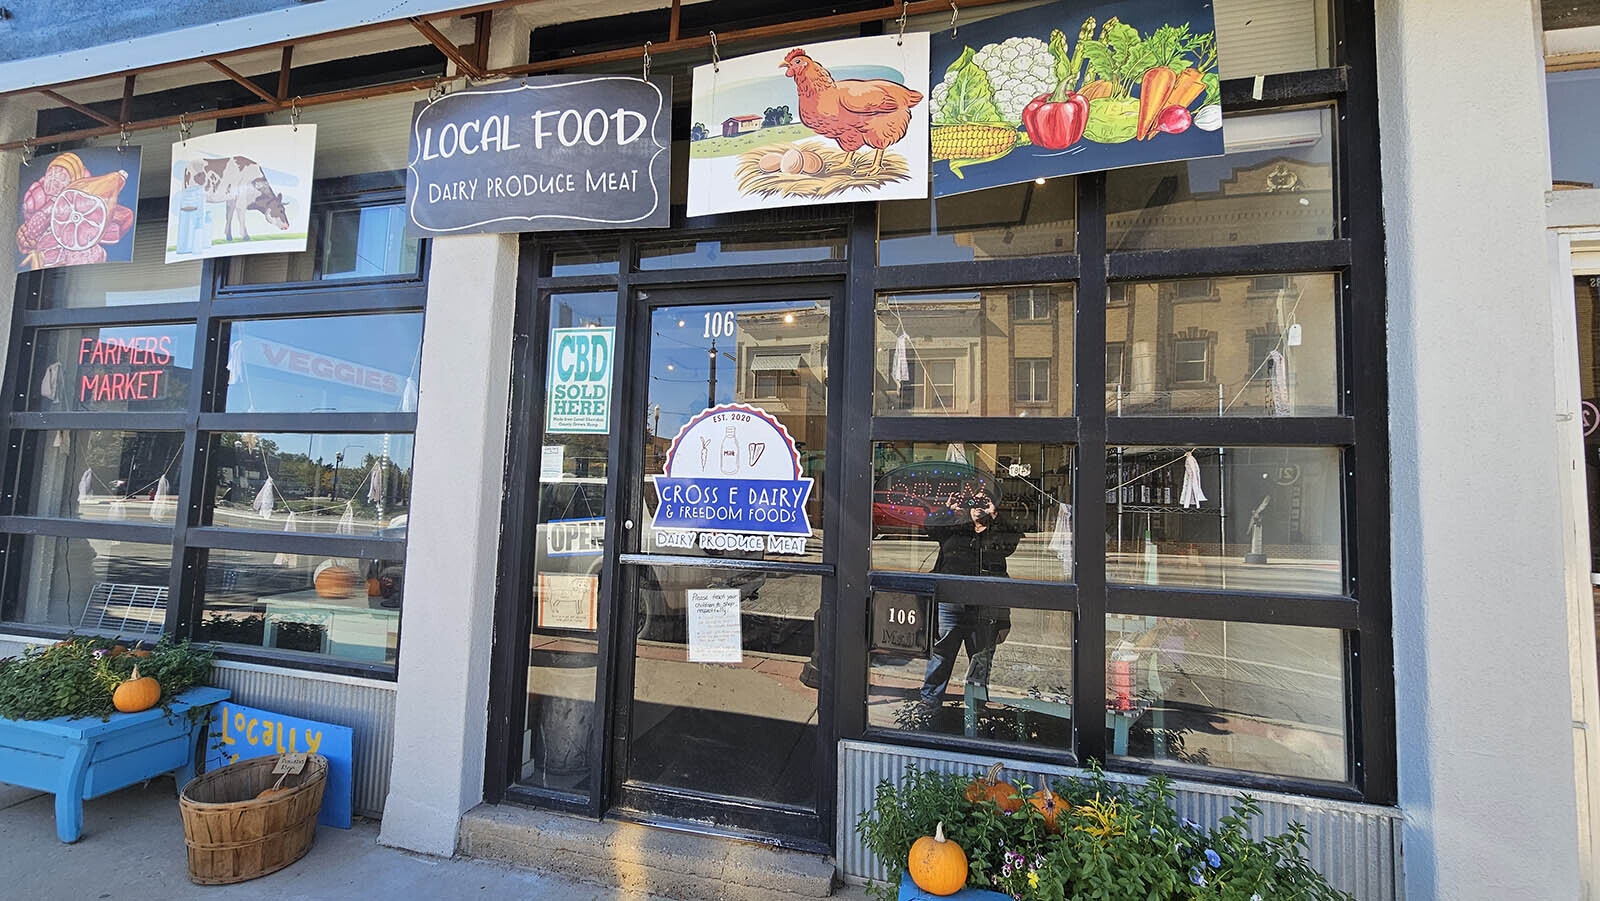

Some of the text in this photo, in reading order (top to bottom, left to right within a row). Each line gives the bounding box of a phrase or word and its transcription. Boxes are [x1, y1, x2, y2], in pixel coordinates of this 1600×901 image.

[423, 108, 647, 161] LOCAL FOOD
[429, 169, 638, 204] DAIRY PRODUCE MEAT
[704, 311, 735, 338] 106
[79, 336, 172, 366] FARMERS
[557, 335, 608, 383] CBD
[262, 343, 398, 393] VEGGIES
[80, 370, 164, 402] MARKET
[555, 384, 606, 400] SOLD
[553, 400, 605, 415] HERE
[713, 413, 751, 423] EST. 2020
[662, 484, 803, 509] CROSS E DAIRY
[886, 482, 986, 506] OPEN
[666, 505, 797, 523] & FREEDOM FOODS
[551, 521, 605, 552] OPEN
[657, 532, 806, 551] DAIRY PRODUCE MEAT
[889, 607, 916, 625] 106
